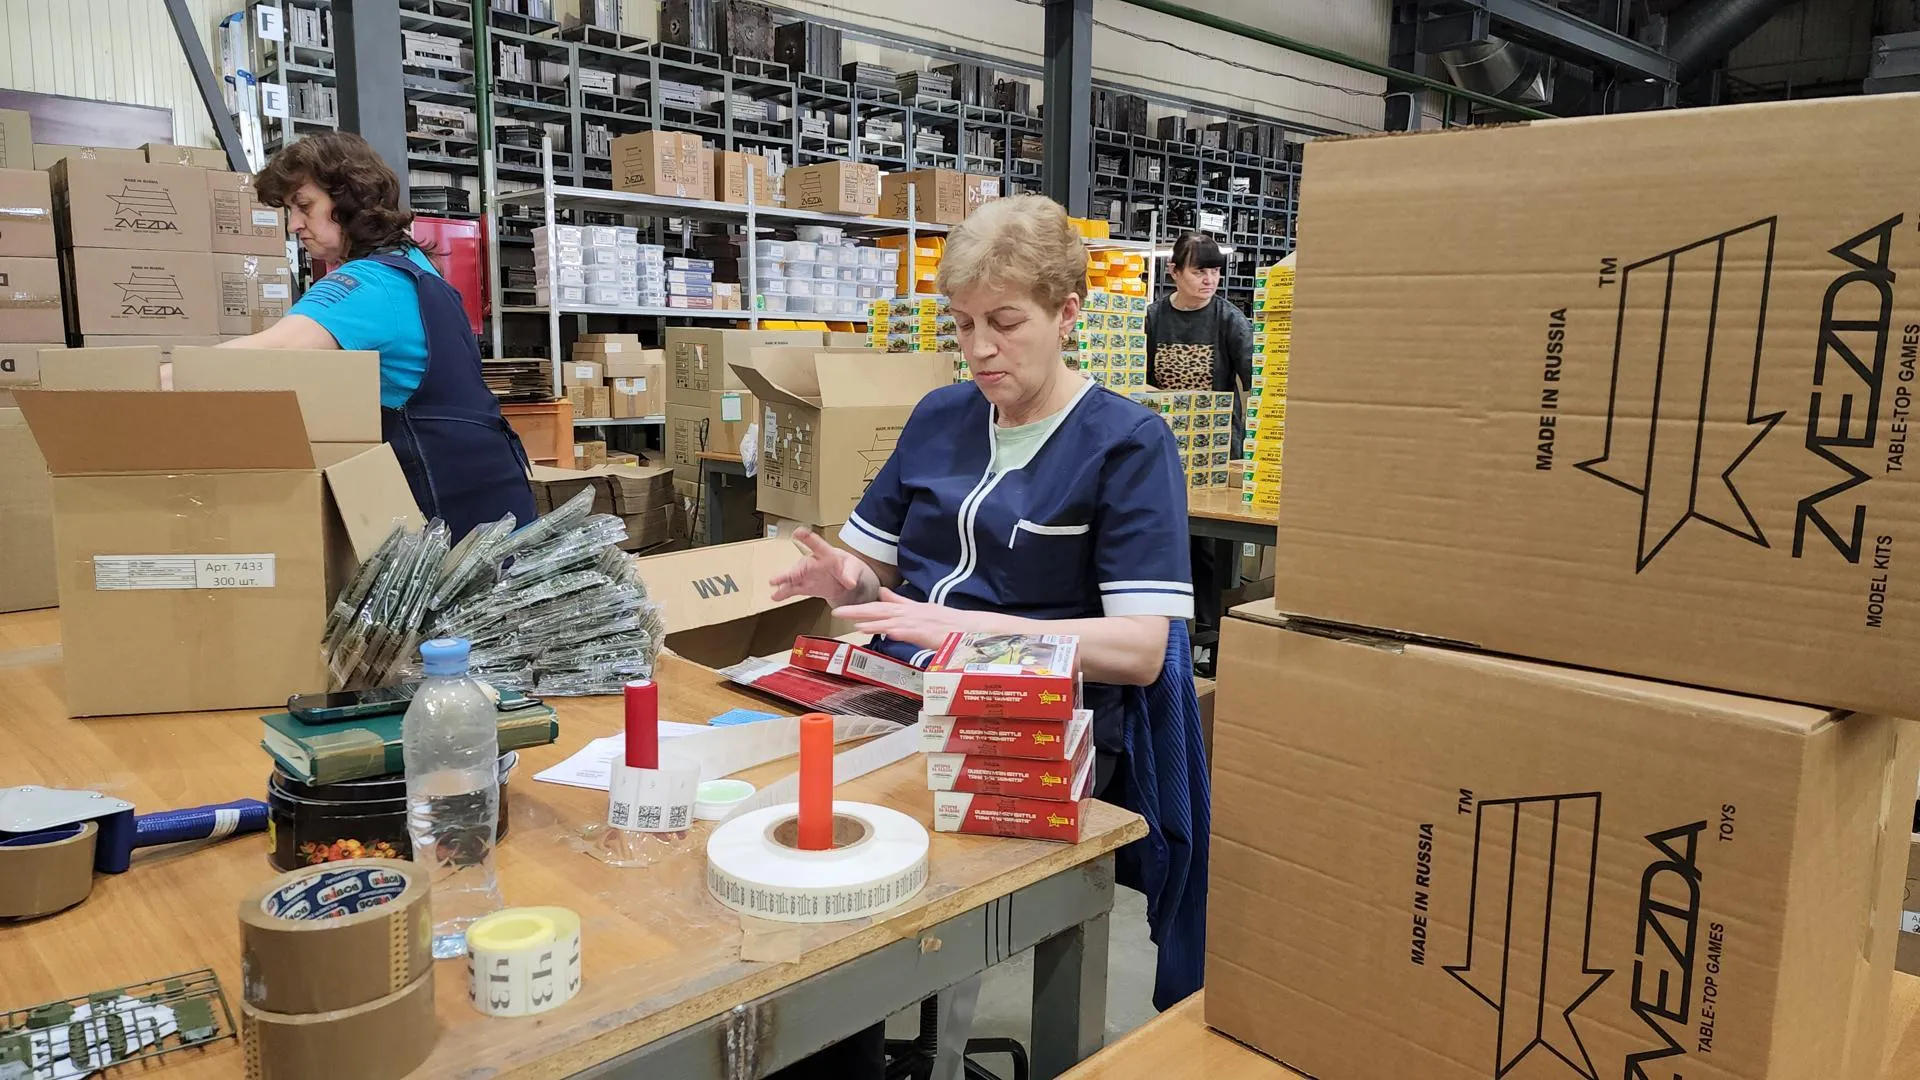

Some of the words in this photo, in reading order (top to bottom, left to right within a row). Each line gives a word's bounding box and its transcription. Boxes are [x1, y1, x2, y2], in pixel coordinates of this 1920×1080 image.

[261, 12, 274, 31] F
[266, 91, 280, 110] E
[114, 217, 179, 231] ZVEZDA
[1598, 257, 1618, 289] TM
[121, 304, 185, 316] ZVEZDA
[1544, 307, 1567, 382] RUSSIA
[1898, 323, 1920, 382] GAMES
[1541, 389, 1559, 409] IN
[1791, 212, 1905, 565] ZVEZDA
[1536, 416, 1557, 471] MADE
[1886, 385, 1912, 475] TABLE-TOP
[205, 562, 231, 573] Арт.
[234, 561, 264, 572] 7433
[1872, 535, 1893, 568] KITS
[213, 577, 235, 587] 300
[238, 577, 258, 587] шт.
[1866, 570, 1887, 629] MODEL
[1458, 788, 1473, 815] TM
[1719, 803, 1736, 842] TOYS
[1416, 823, 1434, 888] RUSSIA
[1414, 891, 1429, 912] IN
[1411, 914, 1427, 966] MADE
[1706, 923, 1724, 974] GAMES
[1698, 977, 1719, 1053] TABLE-TOP
